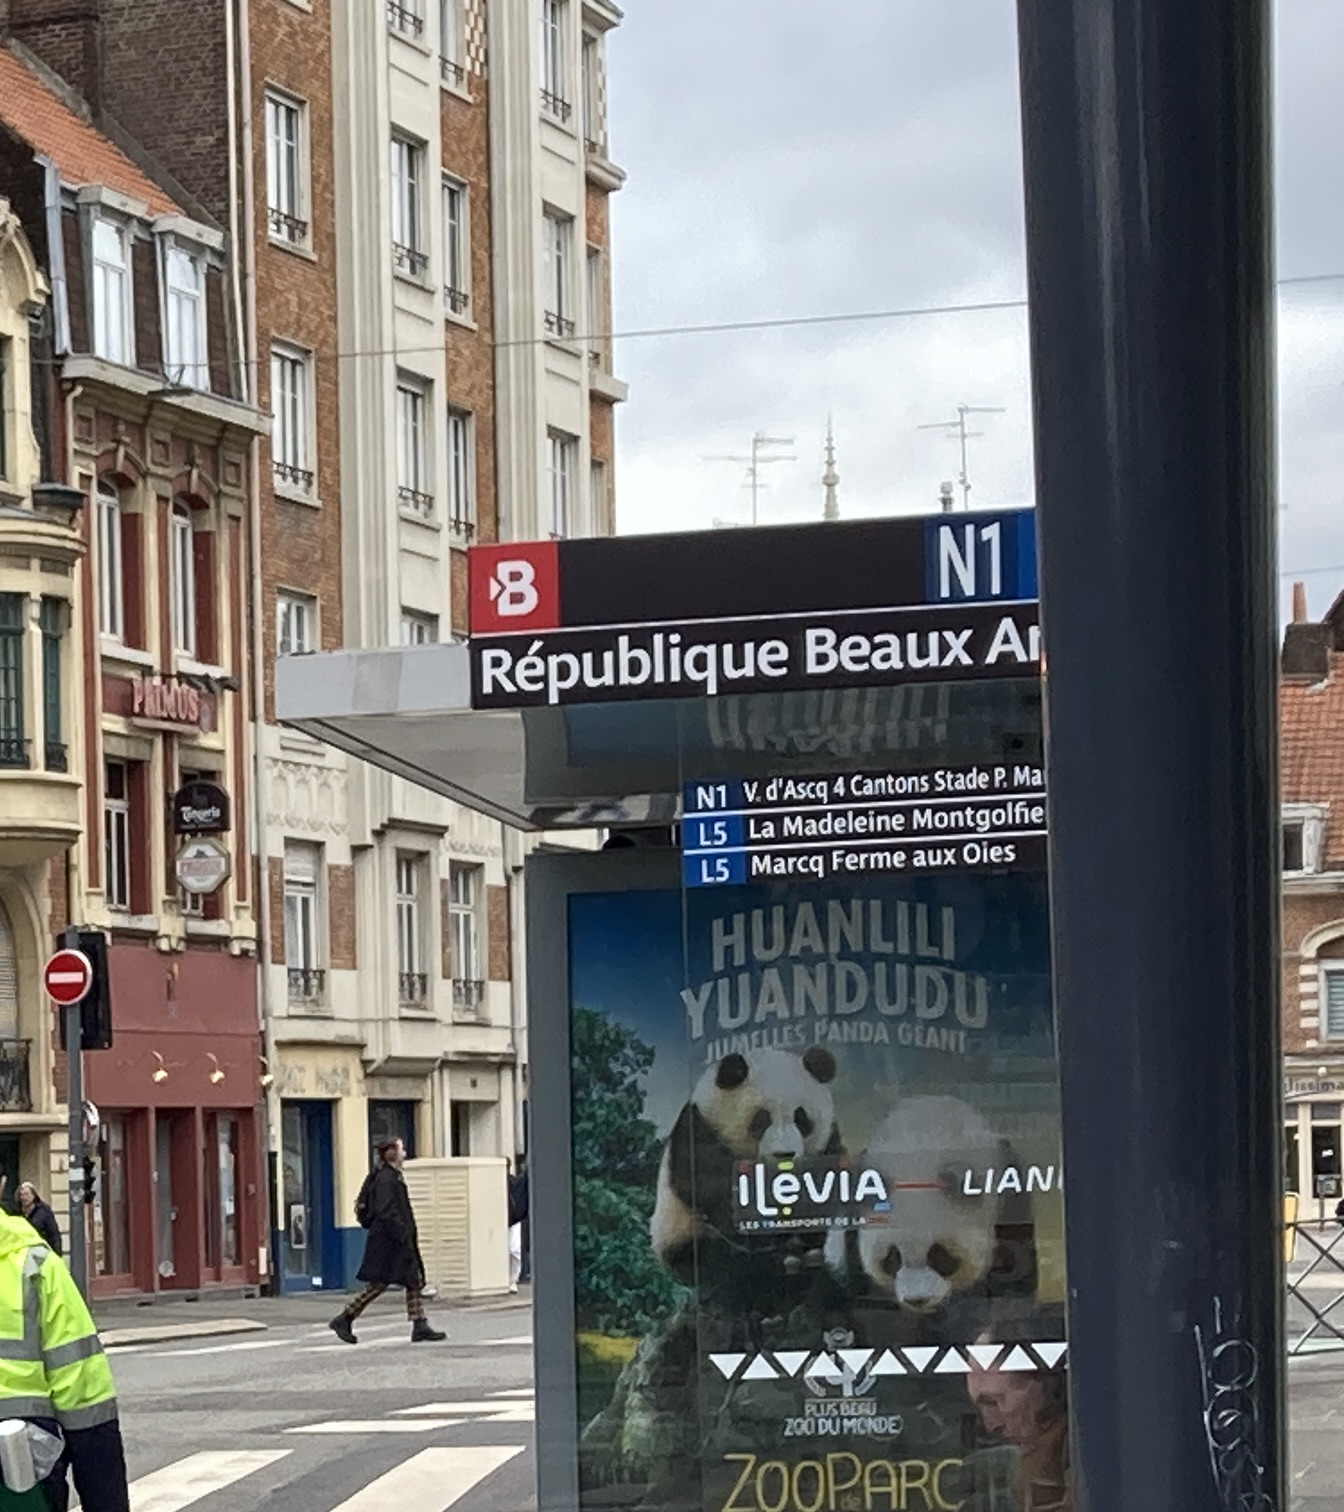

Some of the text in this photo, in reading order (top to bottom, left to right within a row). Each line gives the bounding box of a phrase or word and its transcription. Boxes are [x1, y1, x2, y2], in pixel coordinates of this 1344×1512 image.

[938, 520, 1002, 598] N1
[480, 632, 789, 704] République
[805, 626, 974, 674] Beaux
[696, 784, 727, 810] N1
[742, 780, 762, 803] V.
[765, 777, 828, 804] d'Ascq
[832, 775, 846, 797] 4
[850, 773, 930, 796] Cantons
[934, 766, 990, 792] Stade
[993, 766, 1008, 789] P.
[698, 820, 728, 846] L5
[748, 801, 1044, 840] La Madeleine Montgolfie
[700, 857, 730, 884] L5
[750, 840, 1017, 879] Marcq Ferme aux Oies
[713, 899, 955, 973] HUANLILI
[680, 960, 989, 1040] YUANDUDU
[814, 1019, 890, 1045] PANDA
[817, 1417, 841, 1437] DU
[842, 1415, 901, 1436] MONDE
